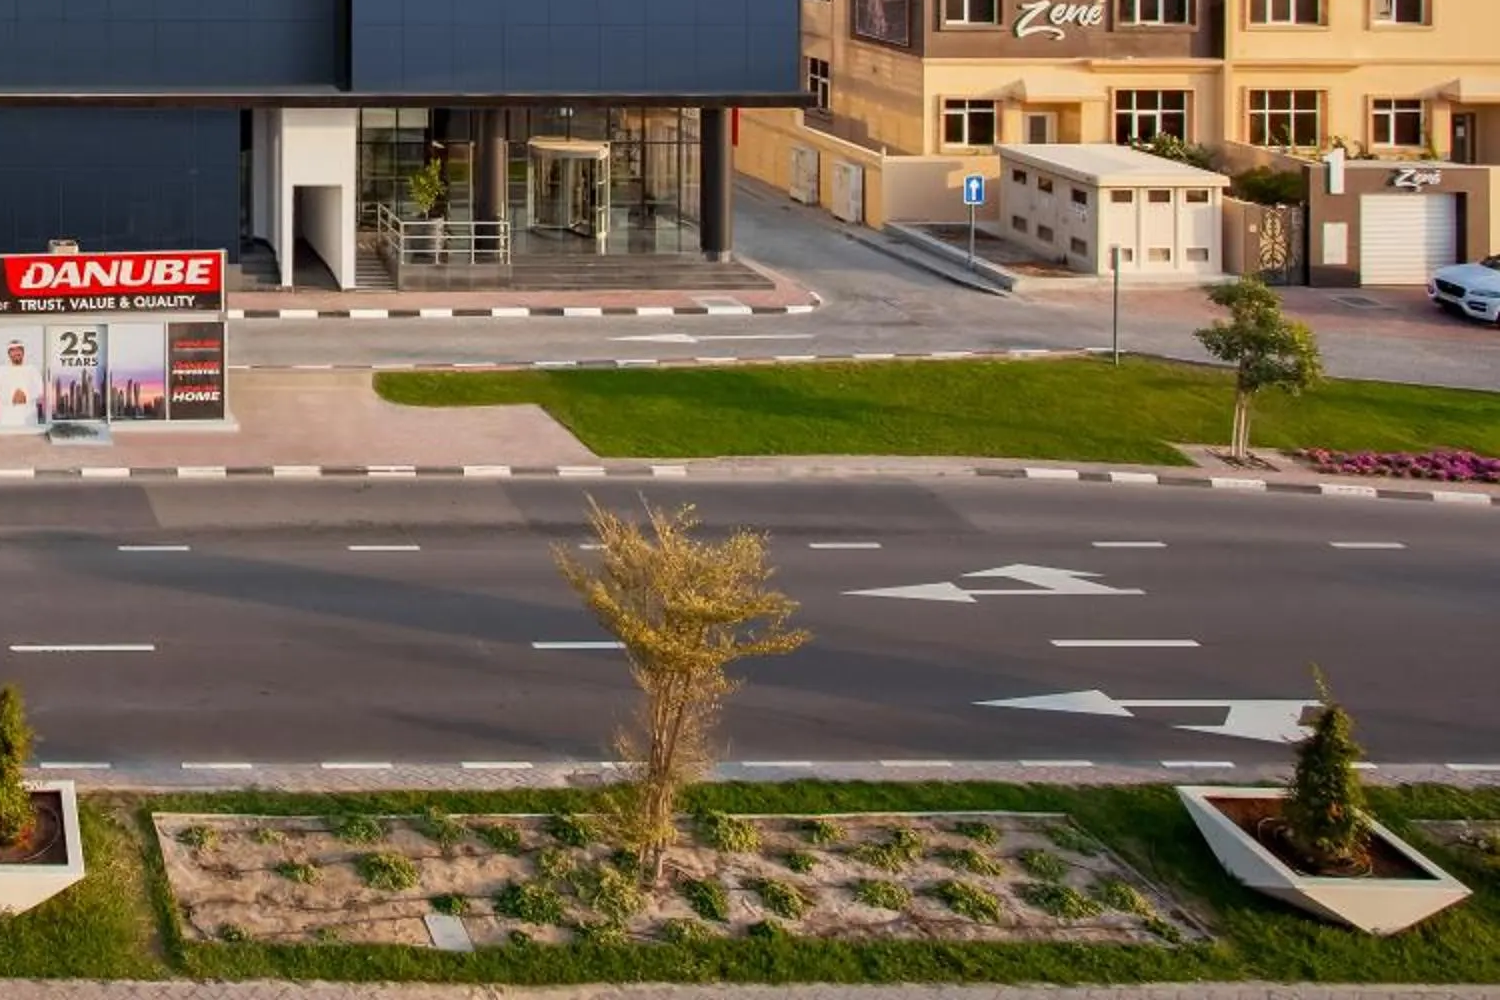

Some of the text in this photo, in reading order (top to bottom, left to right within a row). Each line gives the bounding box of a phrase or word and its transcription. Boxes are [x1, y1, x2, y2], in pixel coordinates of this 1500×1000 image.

[20, 258, 214, 290] DANUBE
[19, 299, 65, 312] TRUST,
[69, 297, 116, 310] VALUE
[119, 296, 131, 309] &
[133, 295, 196, 308] QUALITY
[60, 331, 99, 355] 25
[60, 357, 99, 367] YEARS
[172, 391, 221, 402] HOME
